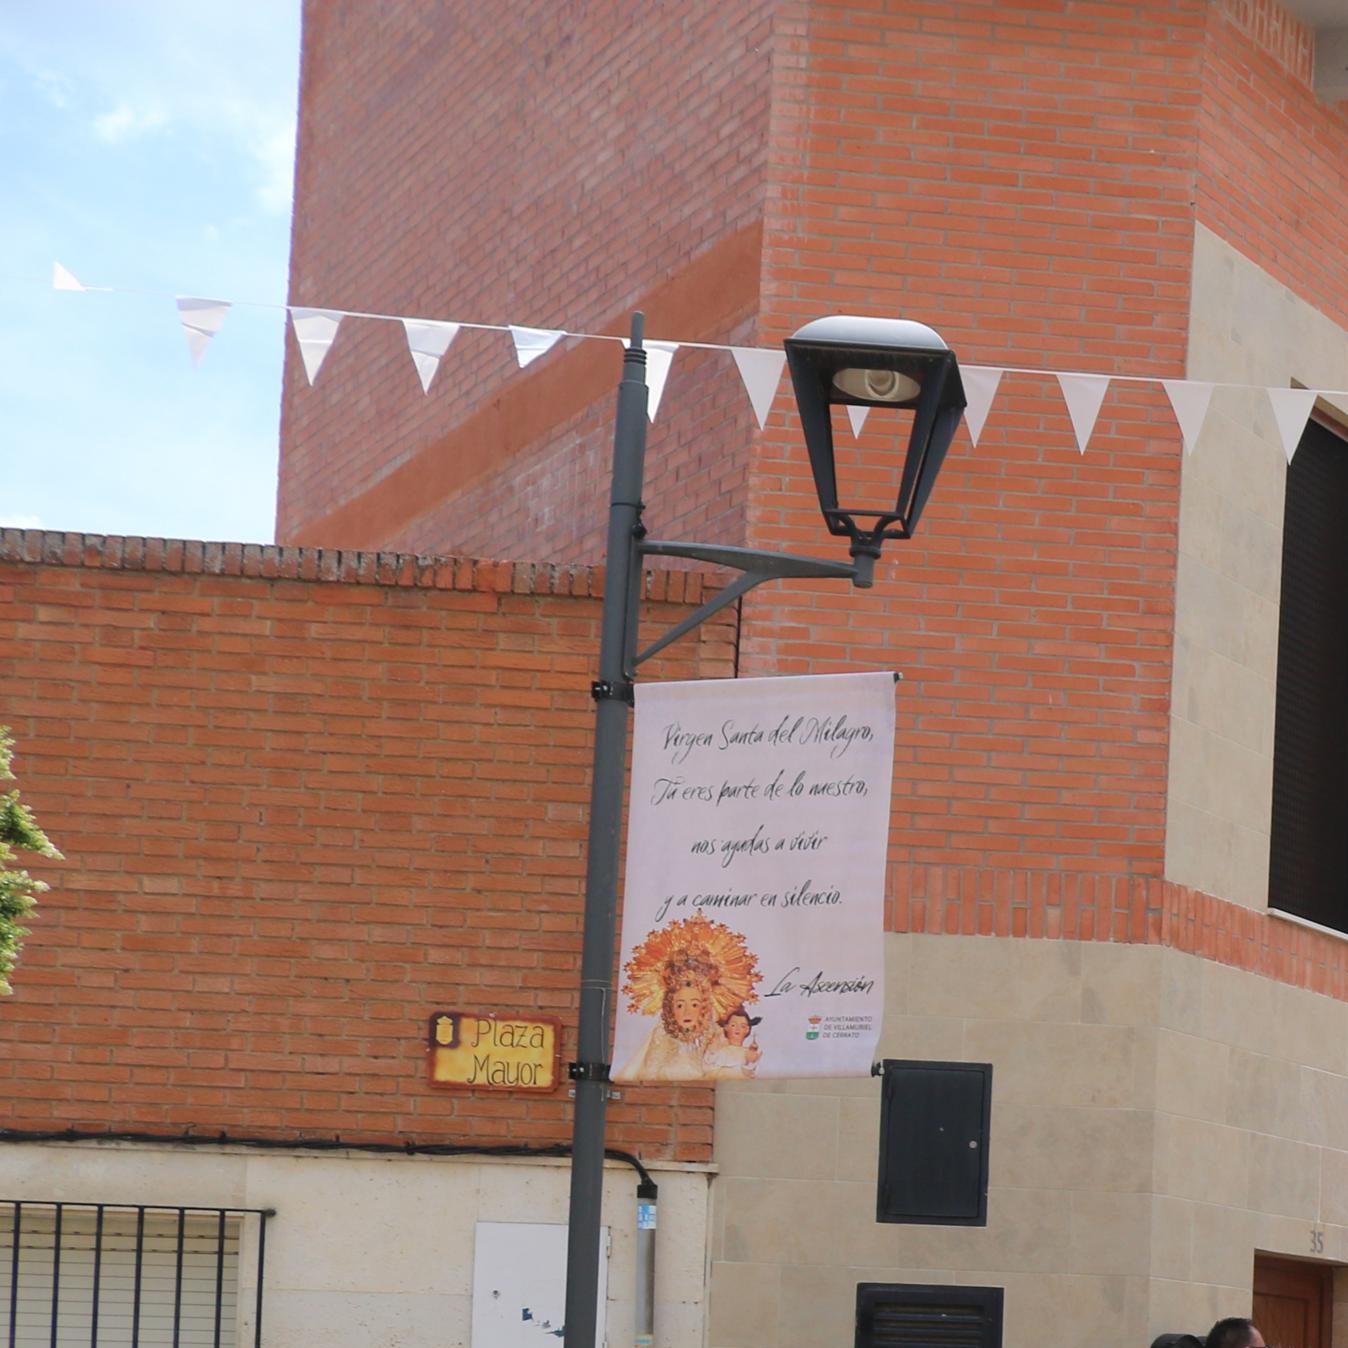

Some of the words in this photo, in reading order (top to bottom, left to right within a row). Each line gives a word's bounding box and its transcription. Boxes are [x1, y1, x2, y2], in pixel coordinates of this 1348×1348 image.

[662, 721, 713, 765] Virgen
[718, 719, 764, 750] Santa
[767, 714, 804, 746] del
[800, 714, 874, 759] Milagro,
[682, 783, 714, 801] eres
[716, 778, 761, 807] parte
[763, 768, 785, 801] de
[789, 769, 806, 797] lo
[808, 775, 869, 797] nuestro,
[690, 839, 716, 855] nos
[720, 824, 772, 869] ayudas
[774, 837, 785, 851] a
[789, 829, 828, 851] vivir
[654, 894, 673, 923] y
[676, 893, 687, 907] a
[691, 887, 758, 908] caminar
[759, 893, 777, 907] en
[782, 879, 843, 908] silencio.
[764, 966, 800, 997] La
[799, 970, 875, 998] Ascensión
[471, 1018, 544, 1048] Plaza
[466, 1054, 544, 1087] Mayor
[1310, 1231, 1324, 1254] 35
